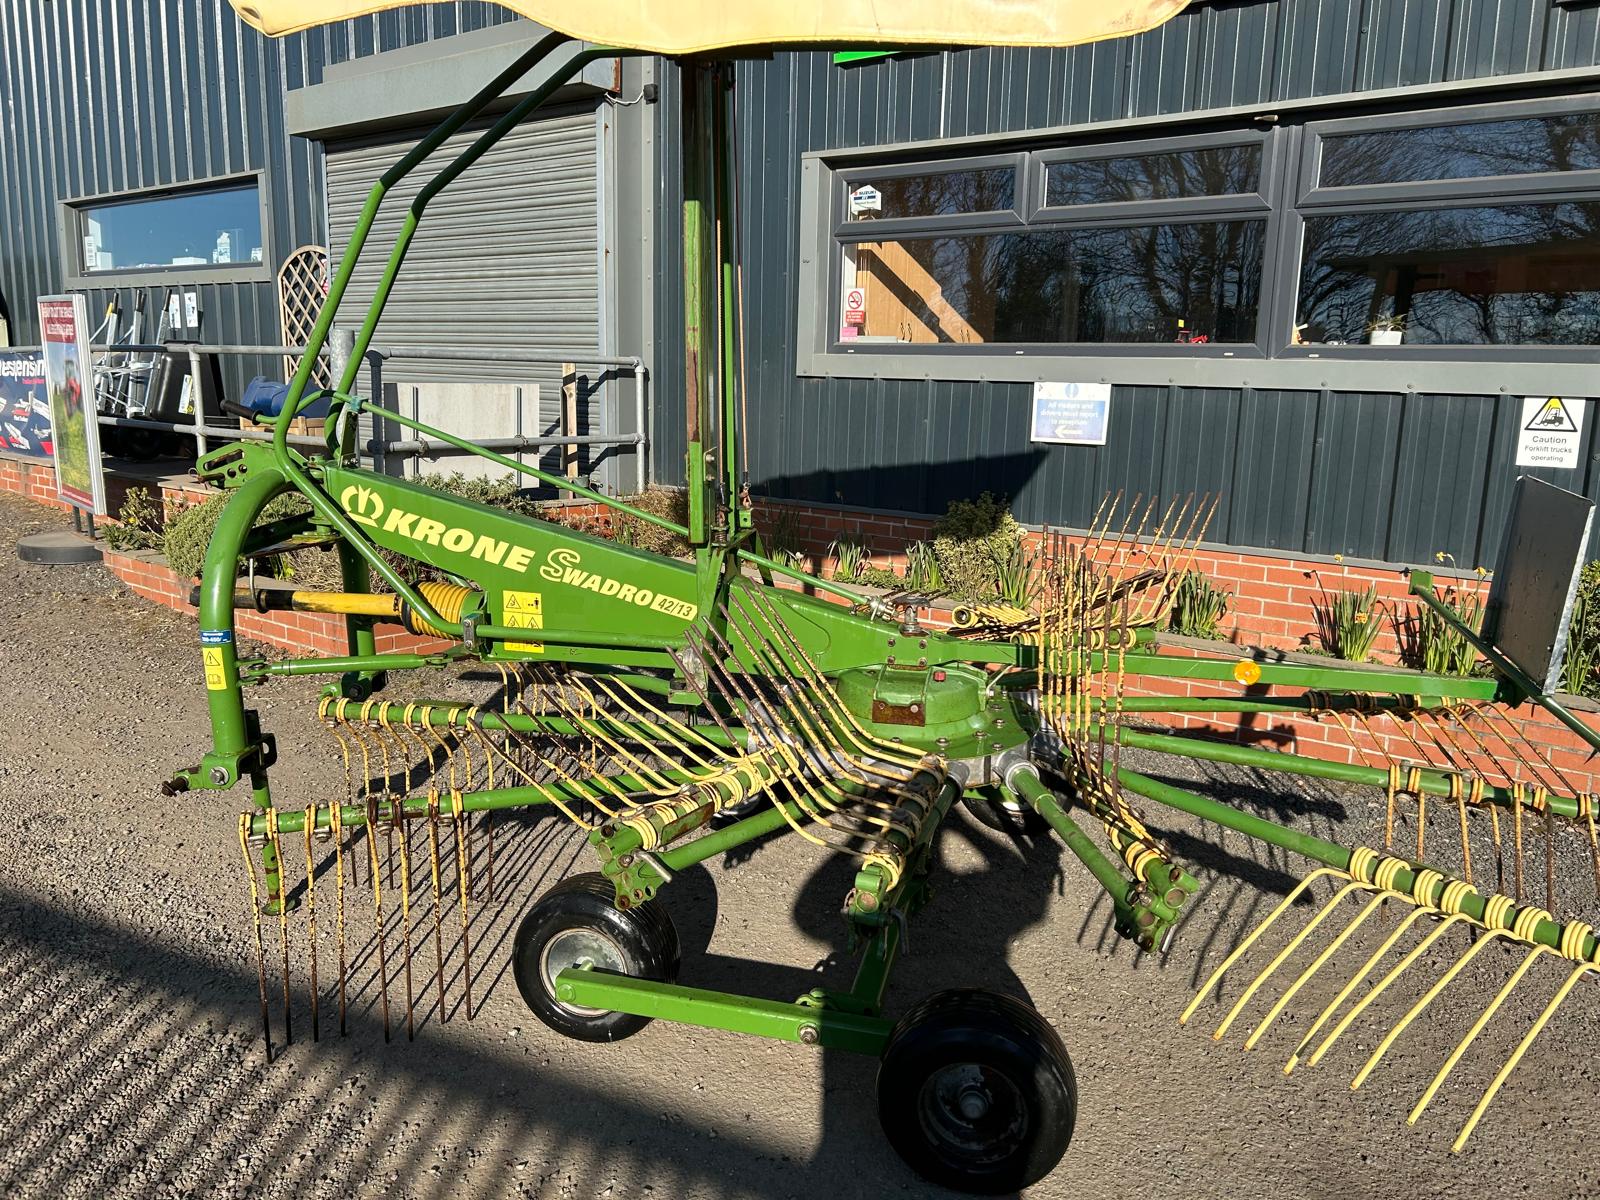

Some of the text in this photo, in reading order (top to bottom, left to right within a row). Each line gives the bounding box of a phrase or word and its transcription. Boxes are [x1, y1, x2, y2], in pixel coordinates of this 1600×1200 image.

[1532, 435, 1567, 444] Caution
[1524, 444, 1573, 454] Forklift trucks
[1530, 455, 1564, 463] operating
[382, 508, 536, 573] KRONE
[657, 598, 693, 617] 42/13
